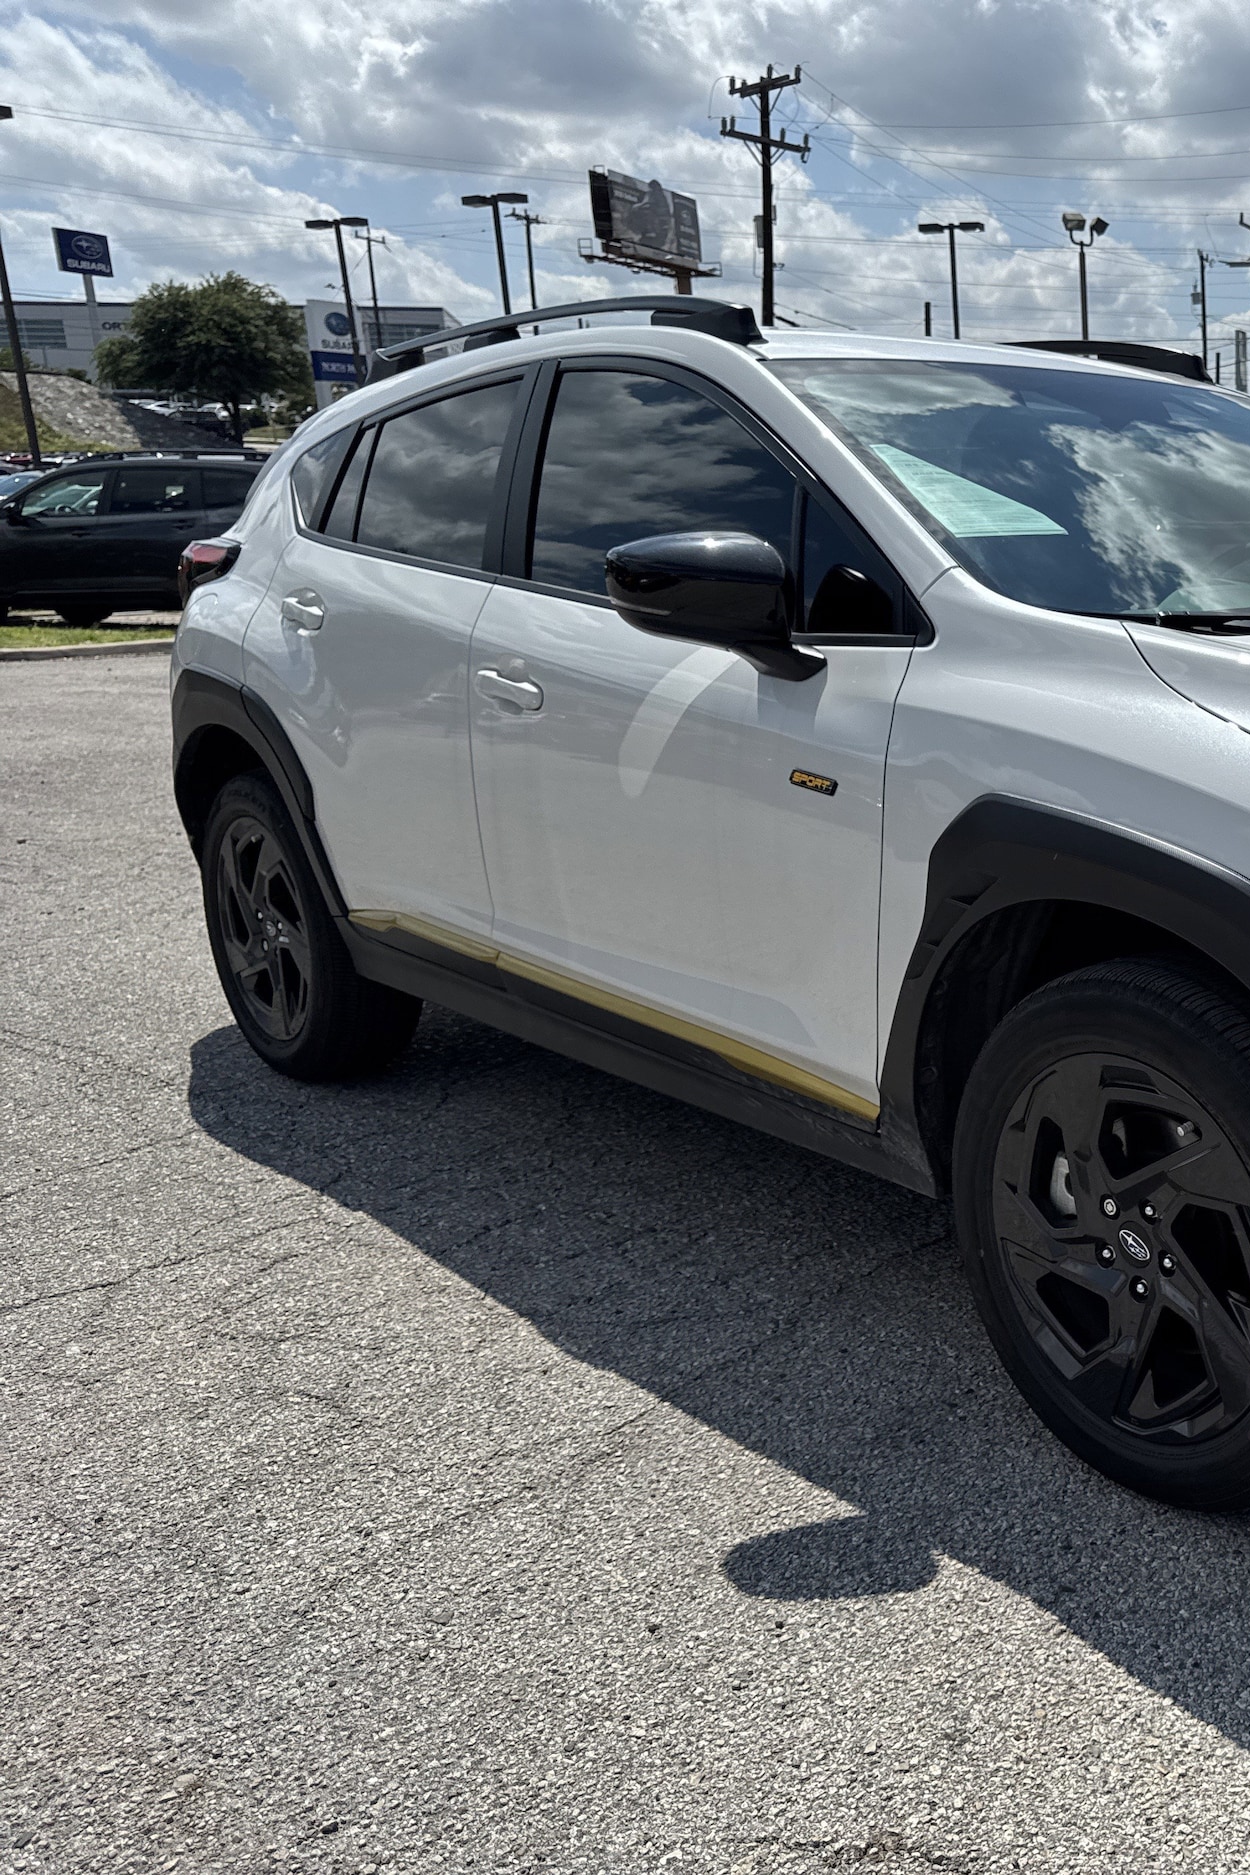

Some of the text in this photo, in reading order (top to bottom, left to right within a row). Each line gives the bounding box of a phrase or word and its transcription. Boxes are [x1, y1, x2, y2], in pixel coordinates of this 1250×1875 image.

[66, 258, 112, 273] SUBARU
[321, 339, 354, 350] SUBAR
[792, 771, 832, 791] SPORT
